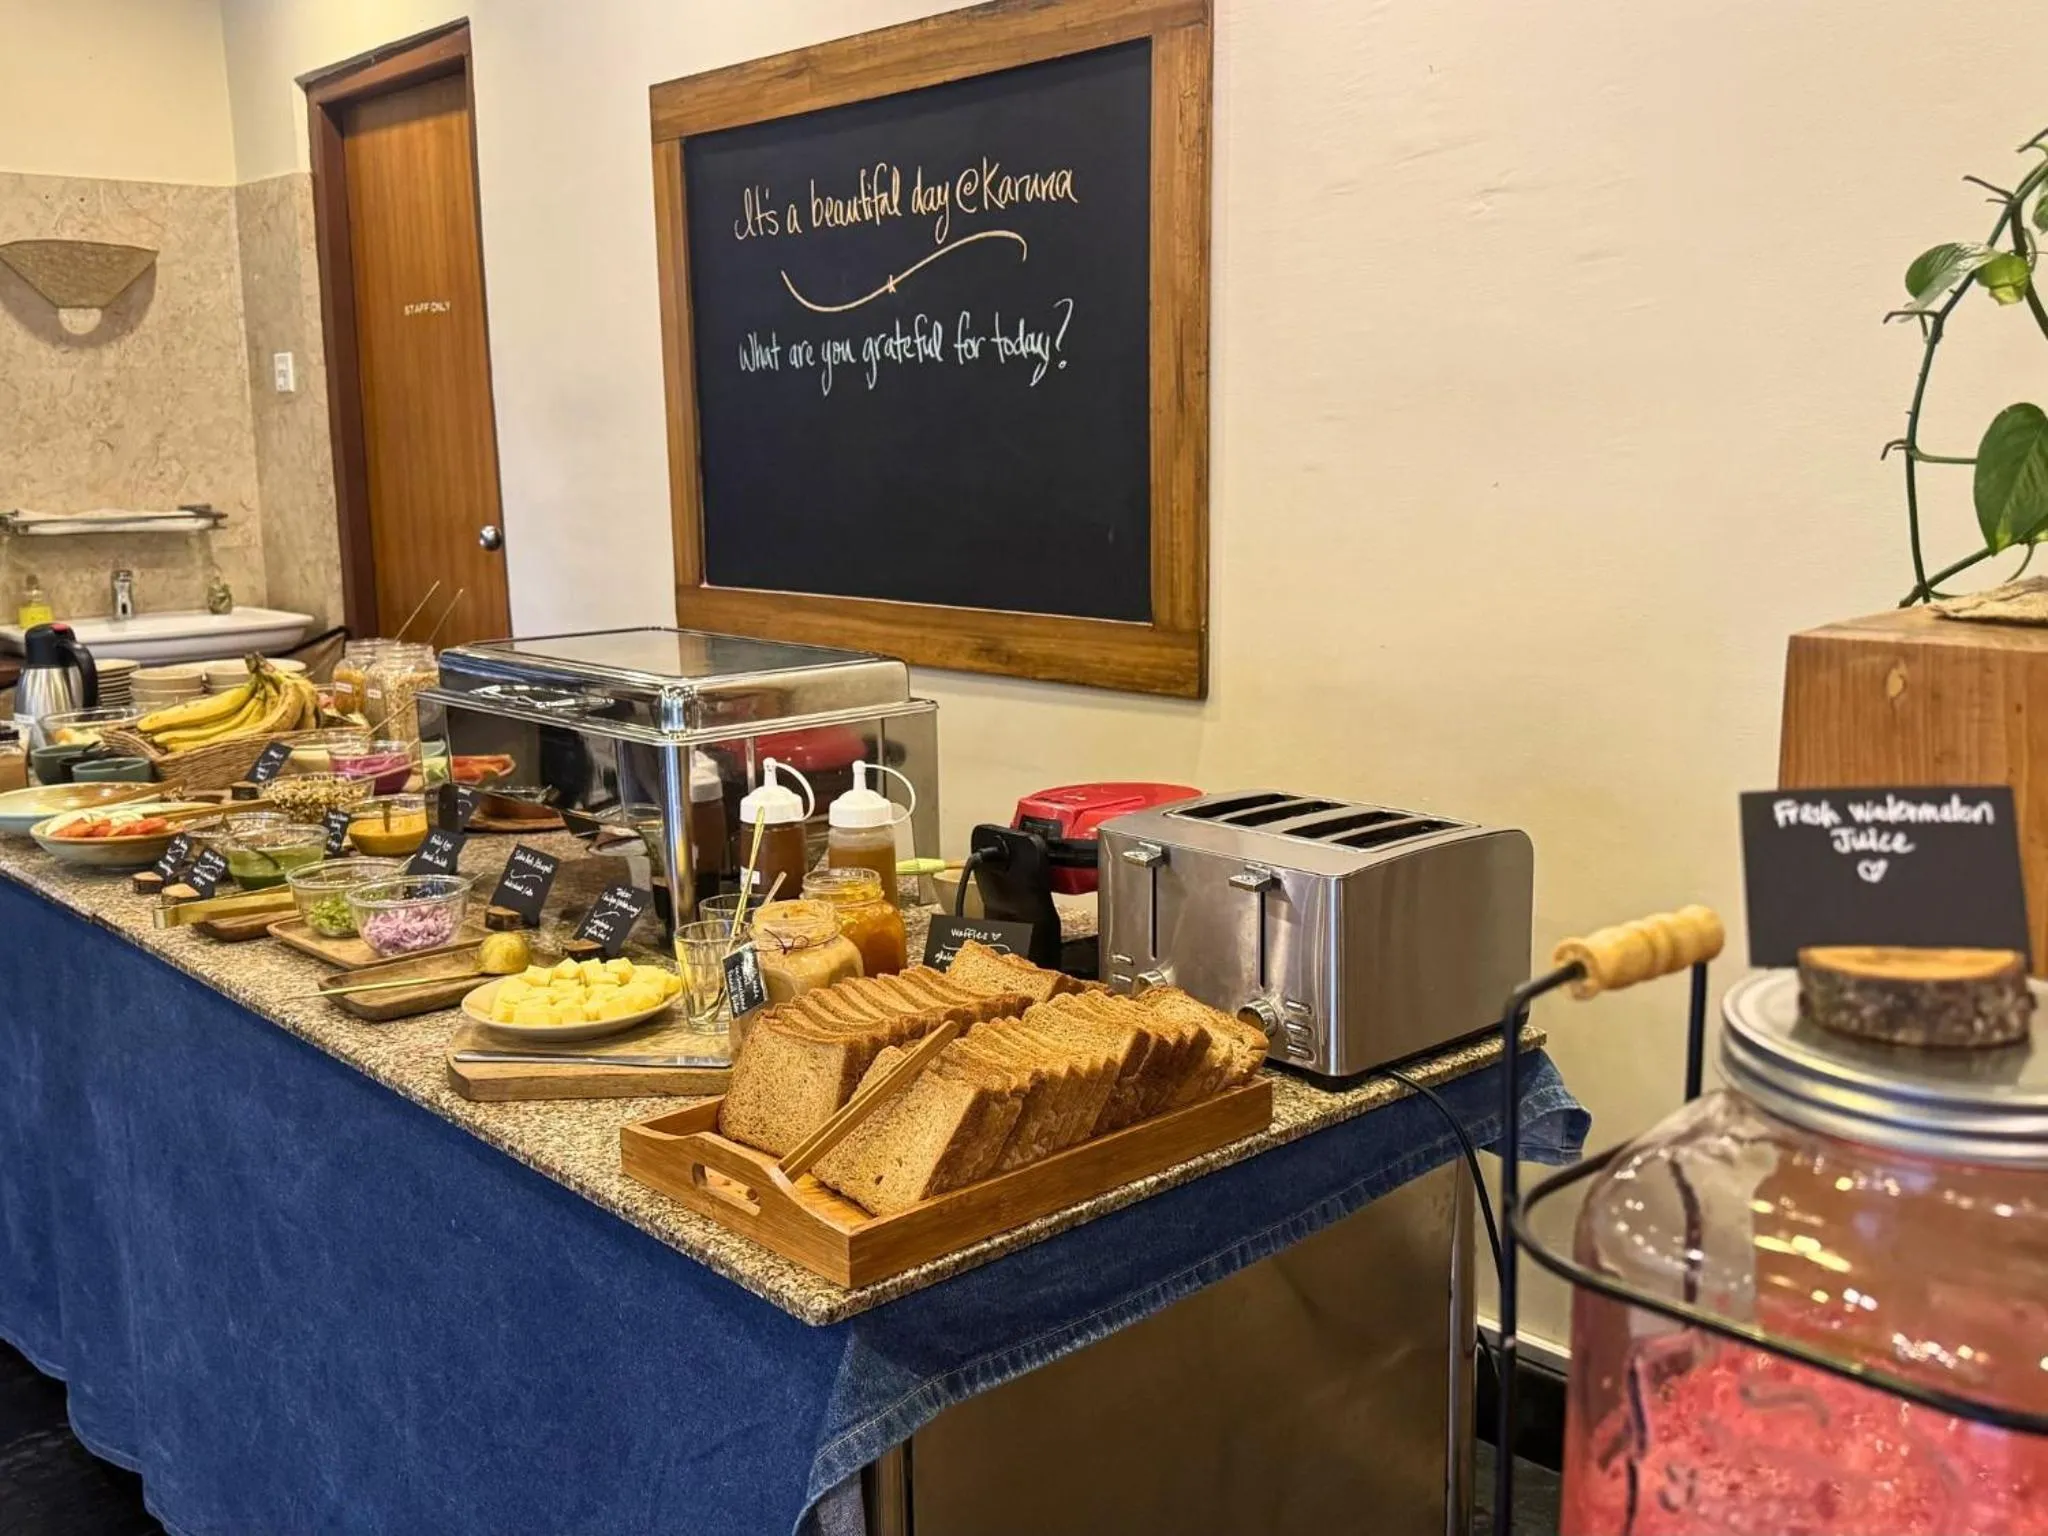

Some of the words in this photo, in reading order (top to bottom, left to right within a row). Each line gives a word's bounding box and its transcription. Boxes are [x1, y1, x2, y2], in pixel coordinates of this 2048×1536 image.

[734, 187, 780, 240] It's
[787, 200, 802, 235] a
[810, 162, 901, 228] beautiful
[911, 166, 950, 244] day
[739, 328, 781, 374] What
[789, 339, 815, 368] are
[821, 333, 854, 397] you
[863, 314, 943, 390] grateful
[953, 311, 985, 365] for
[990, 298, 1074, 386] today?
[1773, 798, 1842, 828] Fresh
[1830, 827, 1916, 853] Juice
